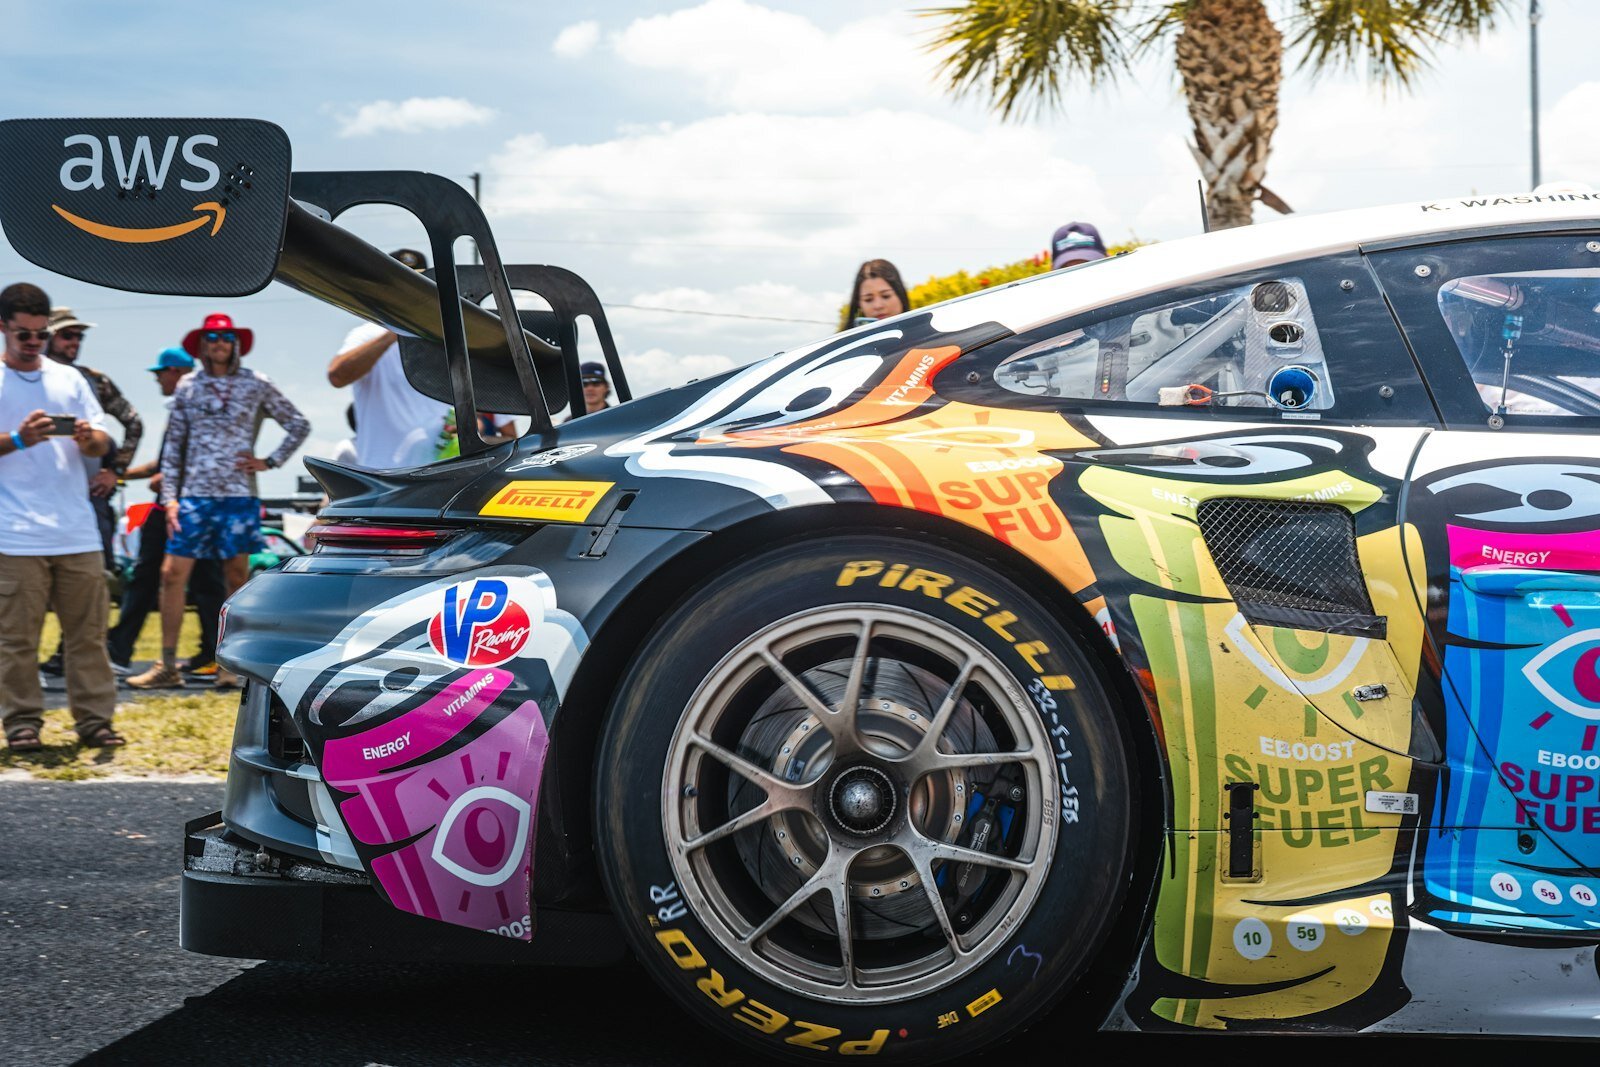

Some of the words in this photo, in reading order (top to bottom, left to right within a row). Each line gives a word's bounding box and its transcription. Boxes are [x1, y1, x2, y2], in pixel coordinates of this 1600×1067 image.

[60, 134, 220, 191] aws
[1421, 203, 1450, 212] K.
[885, 354, 935, 405] VITAMINS
[496, 488, 595, 509] PIRELLI
[938, 469, 1060, 509] SUP
[983, 503, 1061, 545] FU
[1482, 545, 1551, 565] ENERGY
[443, 579, 508, 664] VP
[473, 624, 530, 657] Racing
[836, 560, 1076, 691] PIRELLI
[443, 672, 494, 717] VITAMINS
[362, 731, 411, 760] ENERGY
[1259, 736, 1357, 761] EBOOST
[1224, 754, 1394, 806] SUPER
[1253, 804, 1381, 848] FUEL
[649, 880, 688, 922] RR
[1498, 882, 1514, 892] 10
[1540, 888, 1556, 900] 5g
[1576, 891, 1591, 901] 10
[1243, 931, 1262, 945] 10
[1297, 926, 1317, 941] 5g
